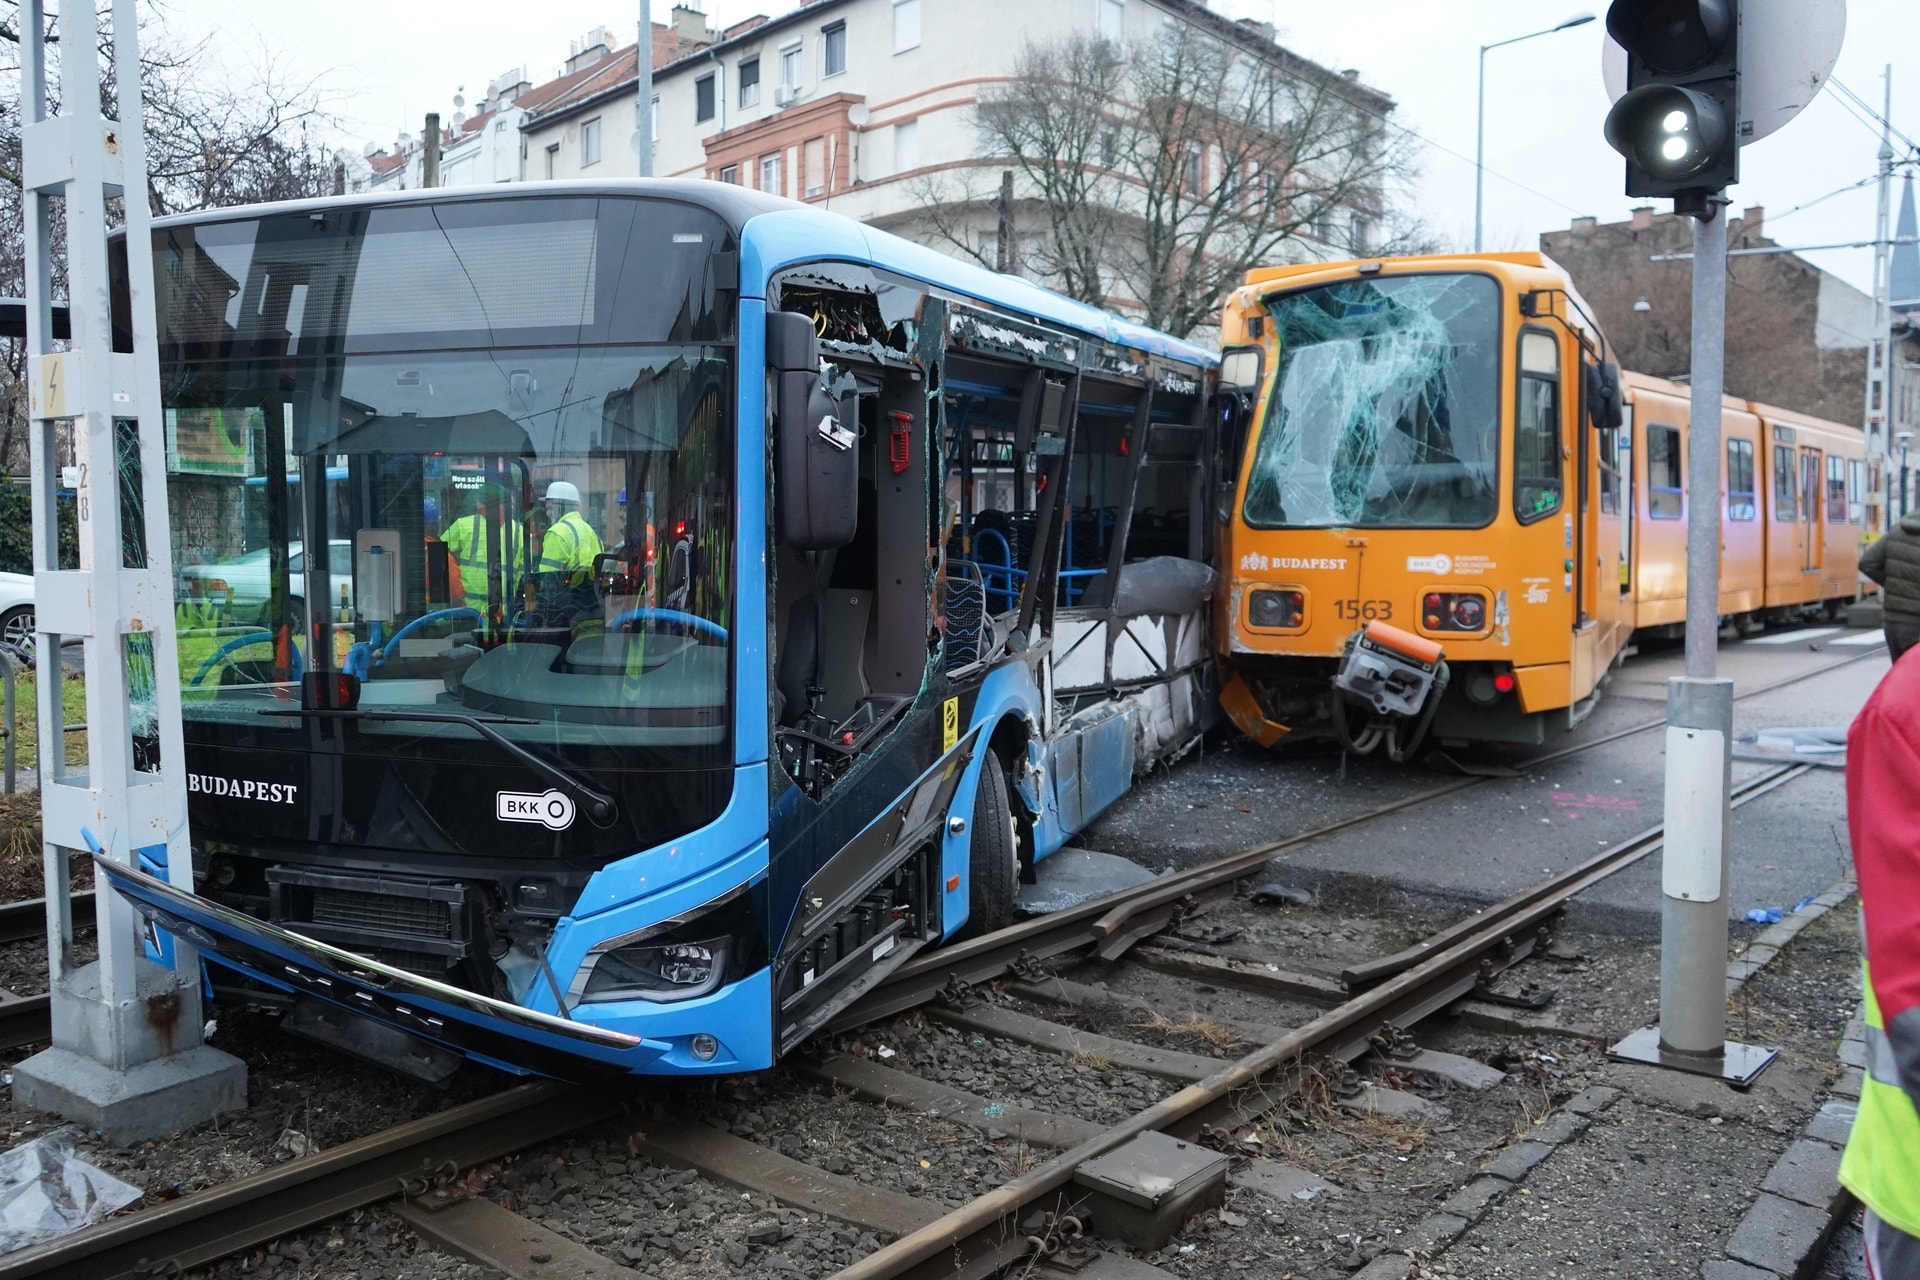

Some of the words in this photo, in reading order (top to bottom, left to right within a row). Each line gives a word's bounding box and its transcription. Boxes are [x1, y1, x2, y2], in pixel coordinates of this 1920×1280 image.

[1272, 557, 1347, 570] BUDAPEST
[1413, 560, 1432, 568] BKK
[1334, 600, 1393, 621] 1563
[188, 773, 297, 804] BUDAPEST
[507, 800, 540, 815] BKK
